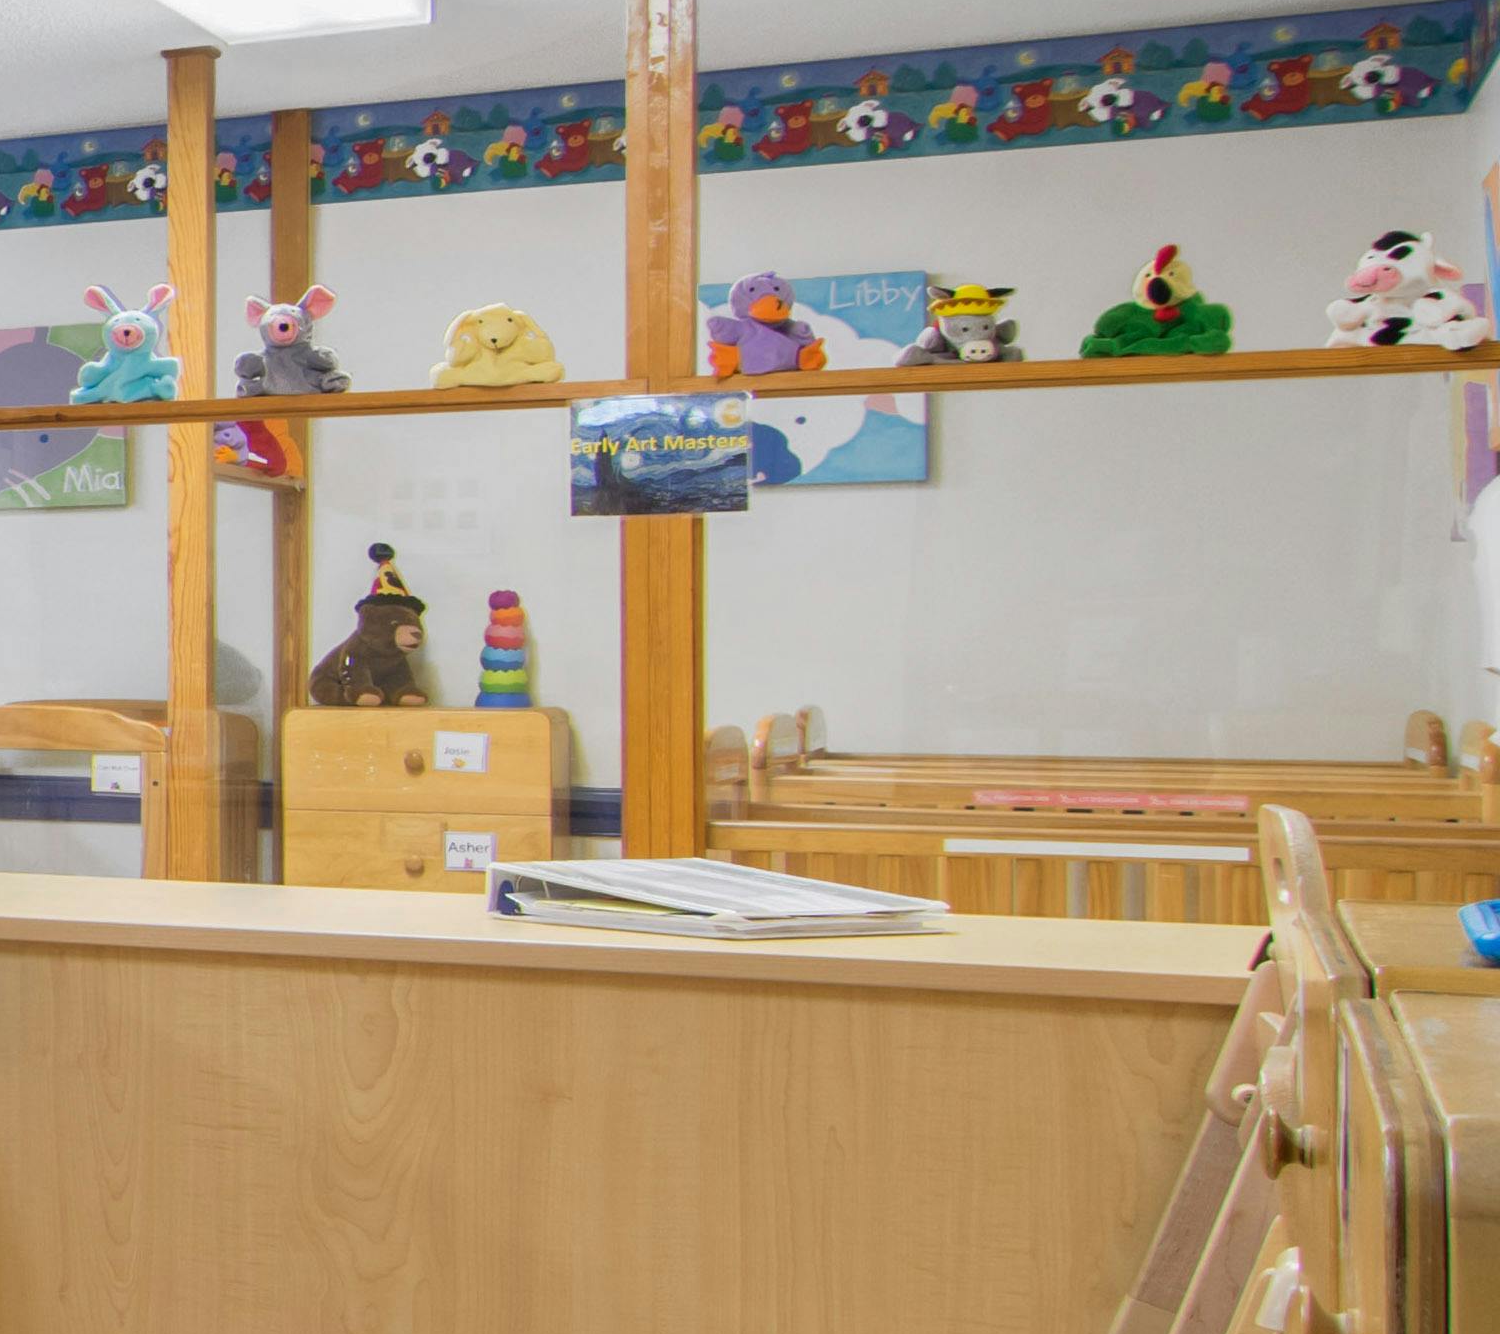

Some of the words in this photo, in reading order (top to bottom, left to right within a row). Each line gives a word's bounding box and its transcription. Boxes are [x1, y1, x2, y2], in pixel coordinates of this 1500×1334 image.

[829, 279, 922, 311] Libby
[571, 437, 620, 456] Early
[626, 436, 658, 452] Art
[664, 434, 749, 451] Masters
[63, 462, 125, 494] Mia
[448, 842, 490, 854] Asher
